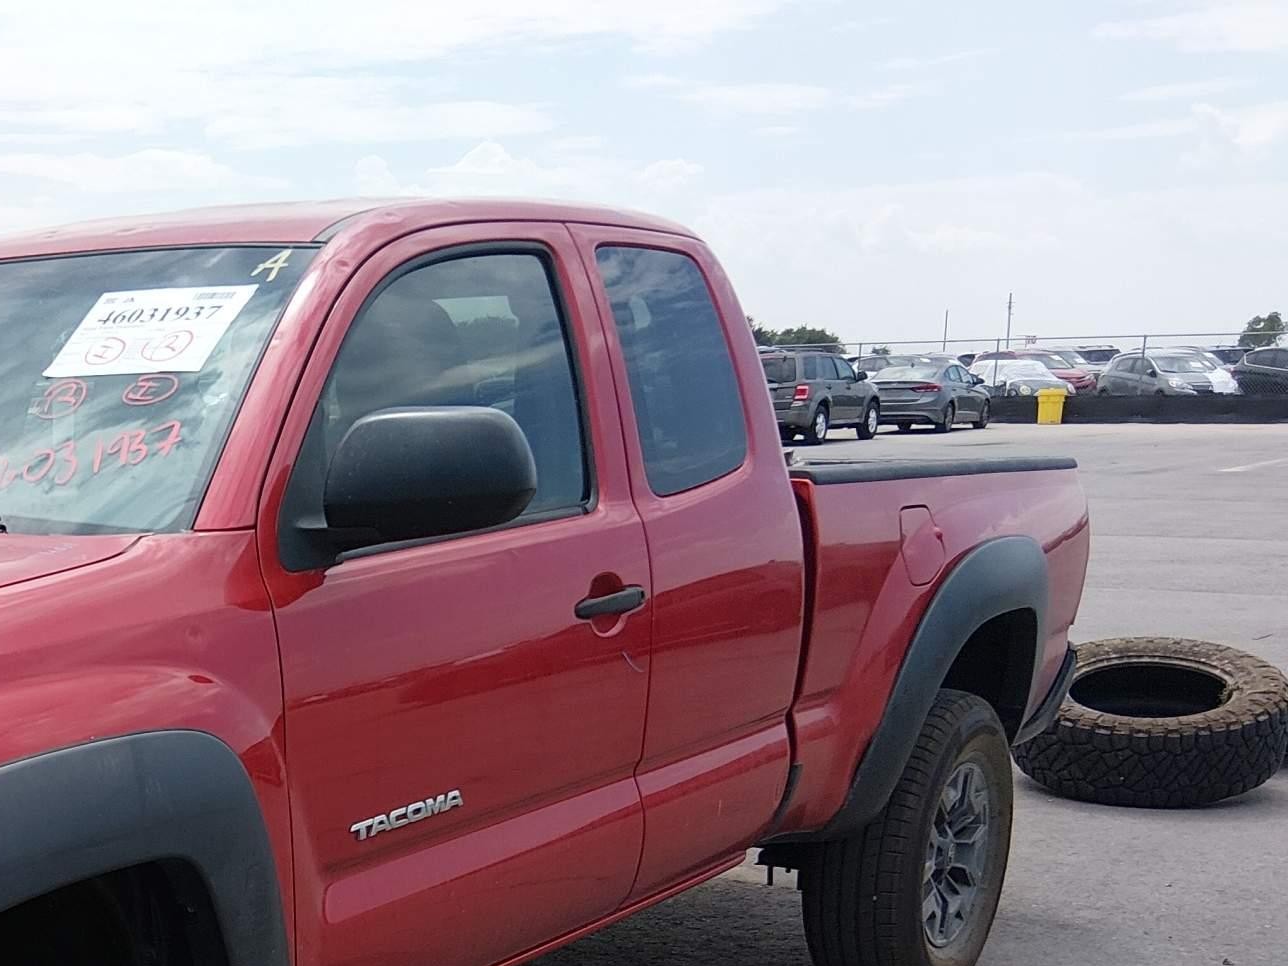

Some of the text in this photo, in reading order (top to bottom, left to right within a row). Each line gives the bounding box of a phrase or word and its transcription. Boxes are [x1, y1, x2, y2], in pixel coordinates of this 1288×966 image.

[249, 248, 292, 282] A
[97, 304, 224, 326] 46031937
[349, 788, 464, 841] TACOMA
